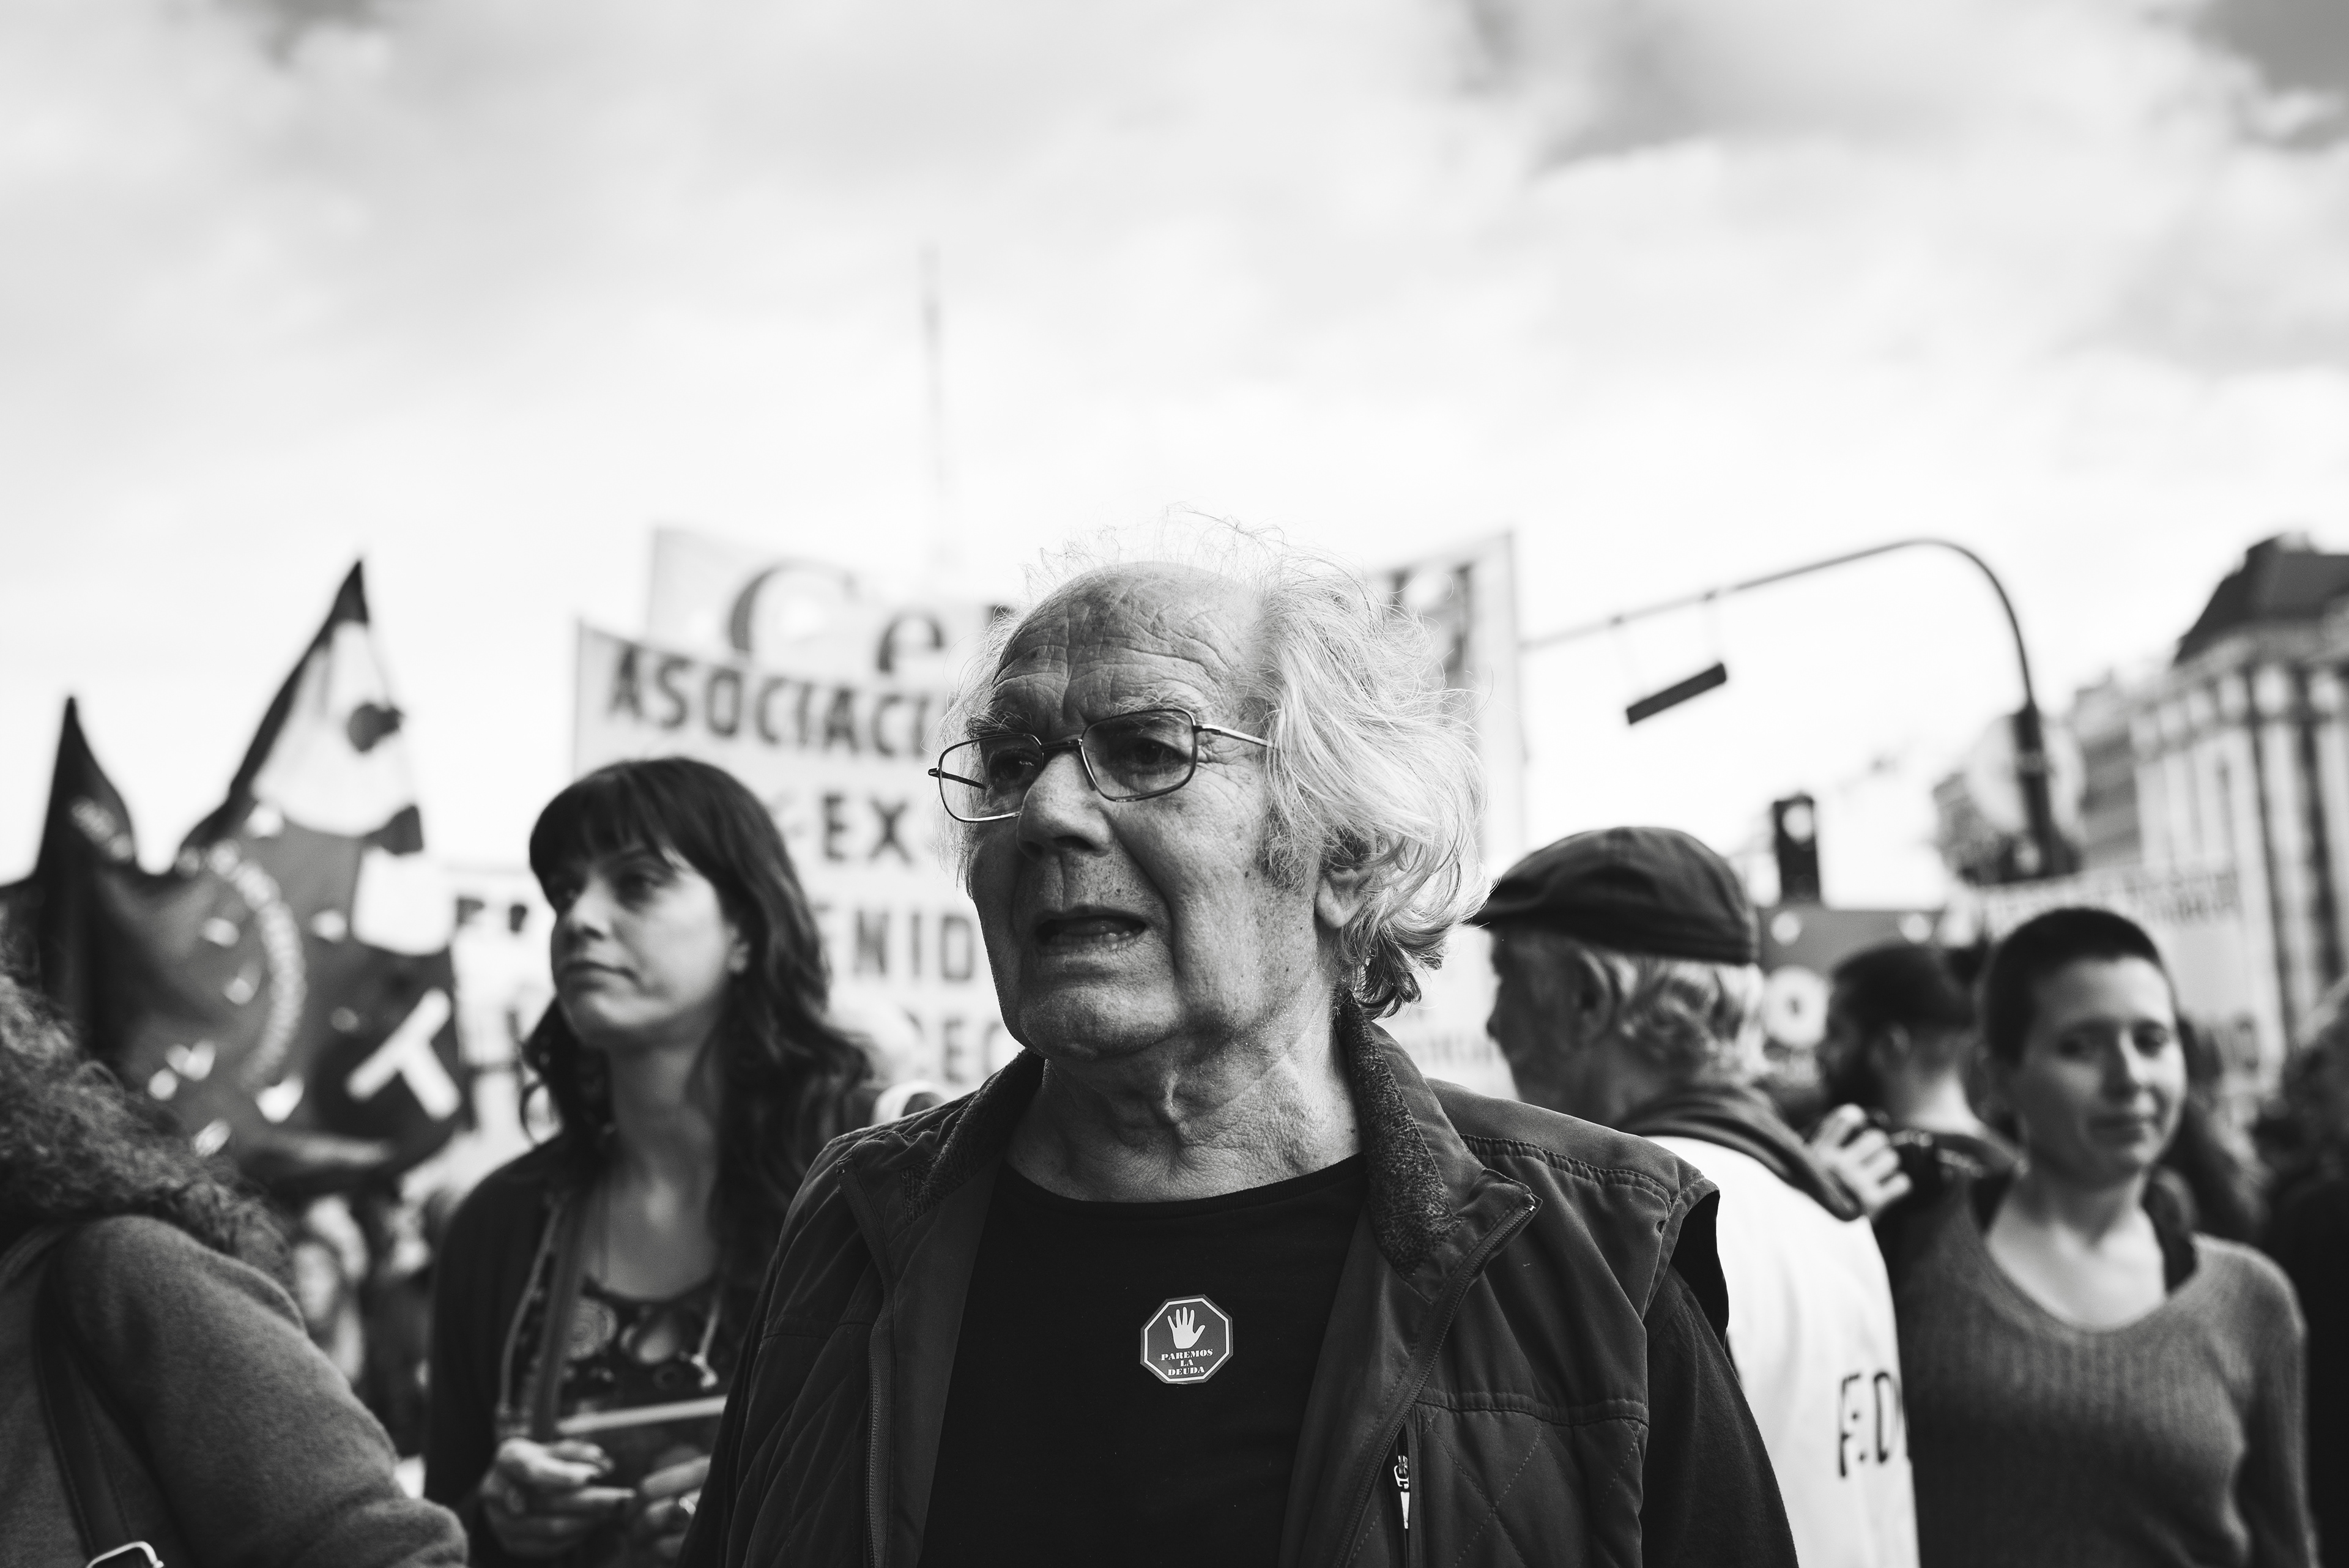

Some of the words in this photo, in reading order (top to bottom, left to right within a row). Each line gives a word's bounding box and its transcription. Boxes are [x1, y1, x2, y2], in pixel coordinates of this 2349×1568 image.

[1161, 1349, 1213, 1361] PAREMOS
[1180, 1359, 1194, 1367] LA
[1168, 1366, 1205, 1376] DEUDA
